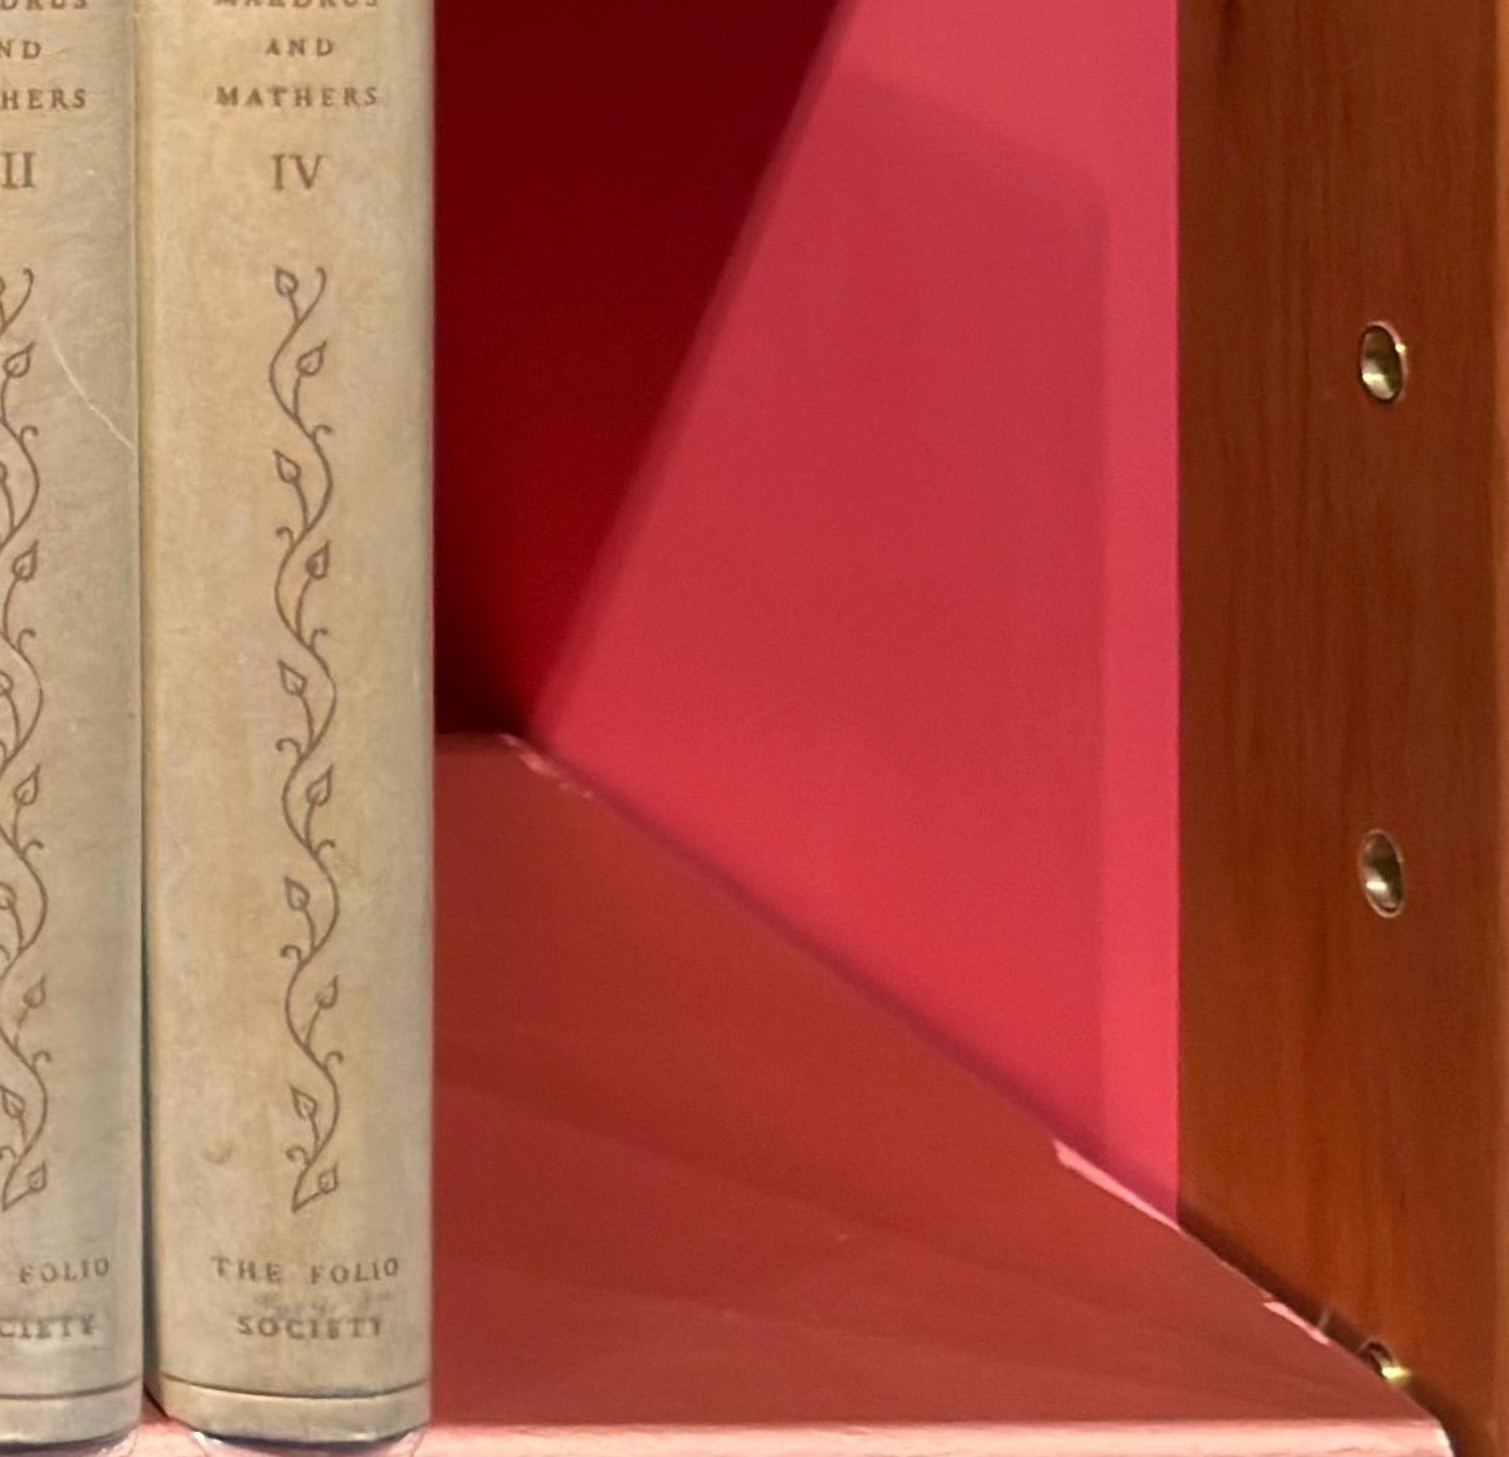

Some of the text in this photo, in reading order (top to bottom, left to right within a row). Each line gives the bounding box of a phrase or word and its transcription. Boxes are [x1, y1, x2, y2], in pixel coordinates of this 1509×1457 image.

[265, 38, 333, 57] AND
[217, 86, 377, 108] MATHERS
[271, 154, 326, 191] IV
[19, 1257, 110, 1284] FOLIO
[211, 1254, 399, 1285] THE FOLIO
